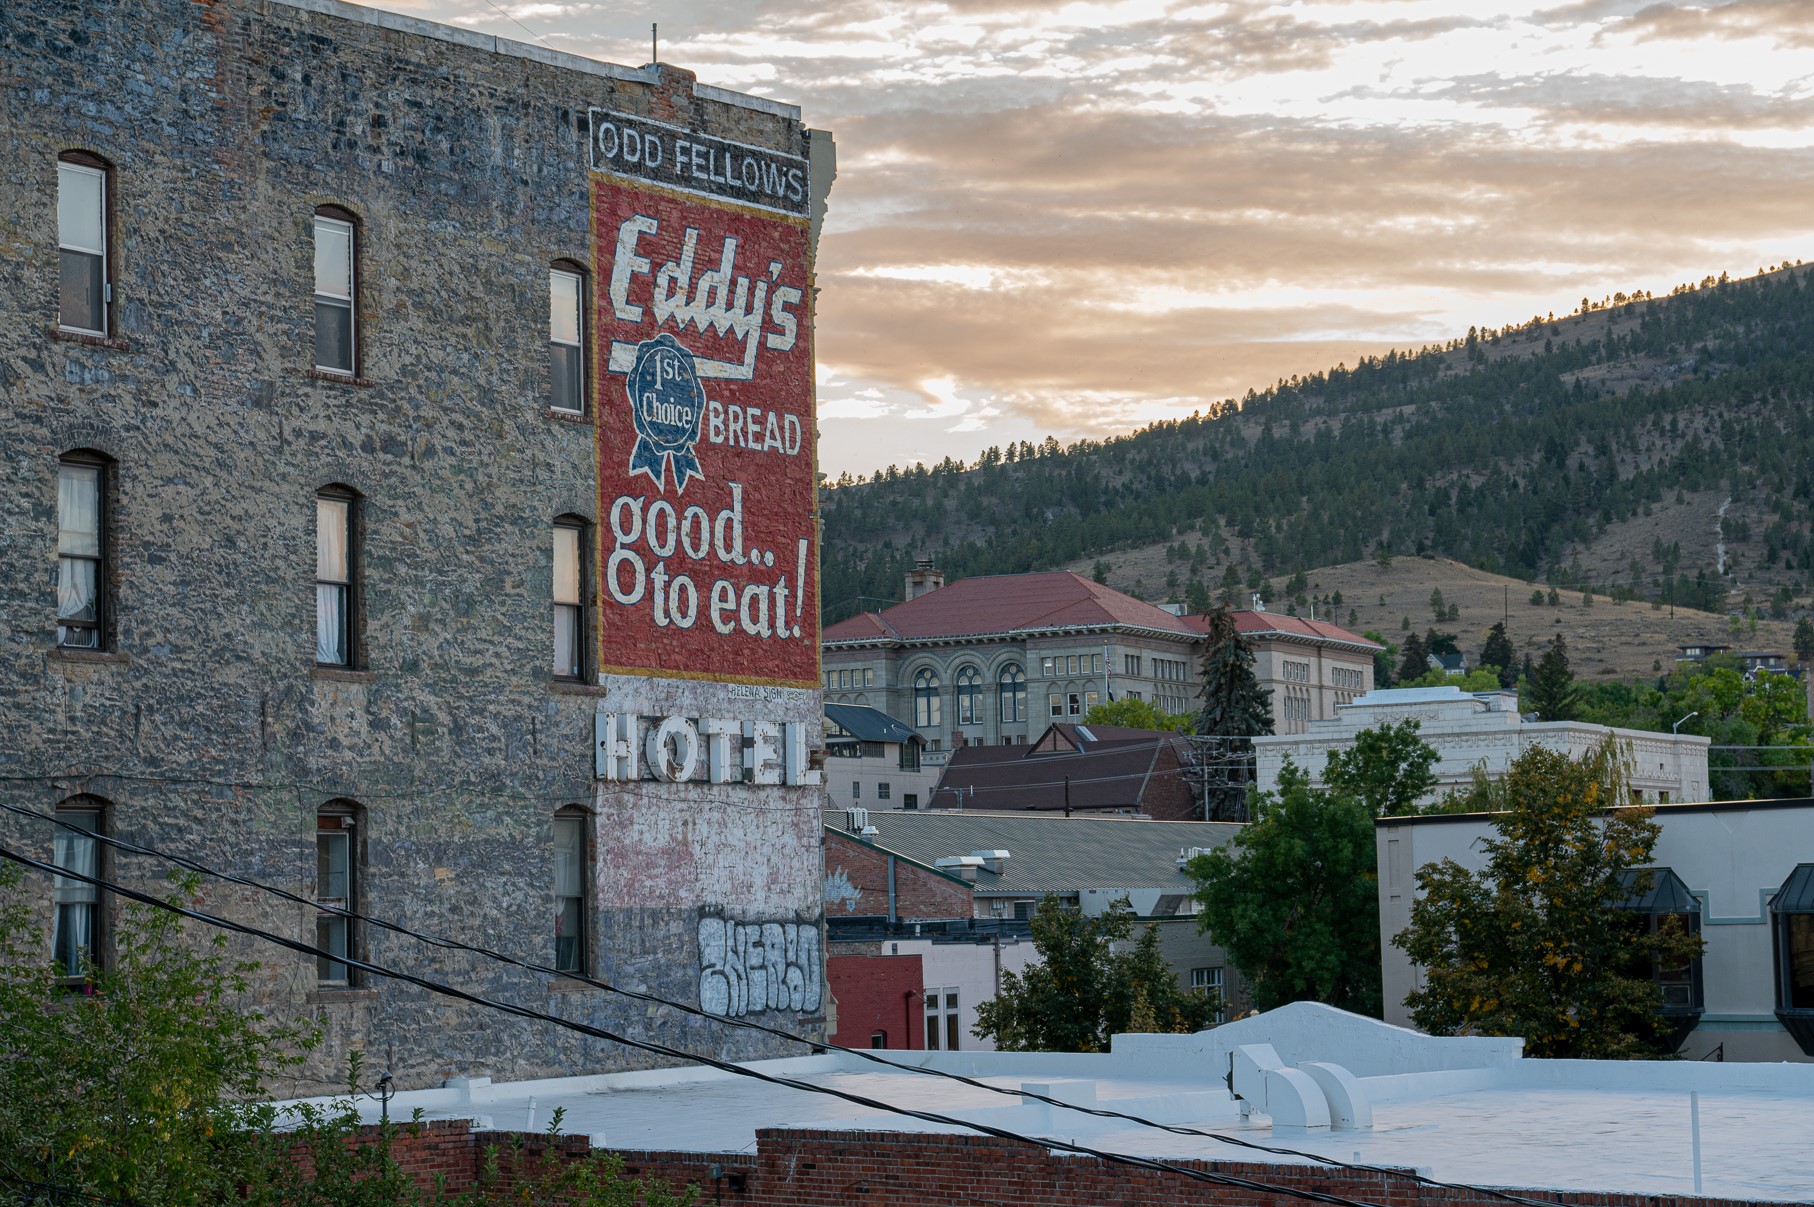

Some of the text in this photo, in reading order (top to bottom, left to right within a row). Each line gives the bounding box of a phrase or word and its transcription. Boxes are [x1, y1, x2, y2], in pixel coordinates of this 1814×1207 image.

[599, 122, 663, 168] ODD
[608, 213, 802, 381] Eddy's
[654, 352, 682, 391] 1st
[642, 392, 692, 430] Choice
[708, 400, 802, 456] BREAD
[650, 538, 808, 639] to eat!
[730, 685, 782, 701] HELENA SIGN
[595, 712, 822, 786] HOTEL
